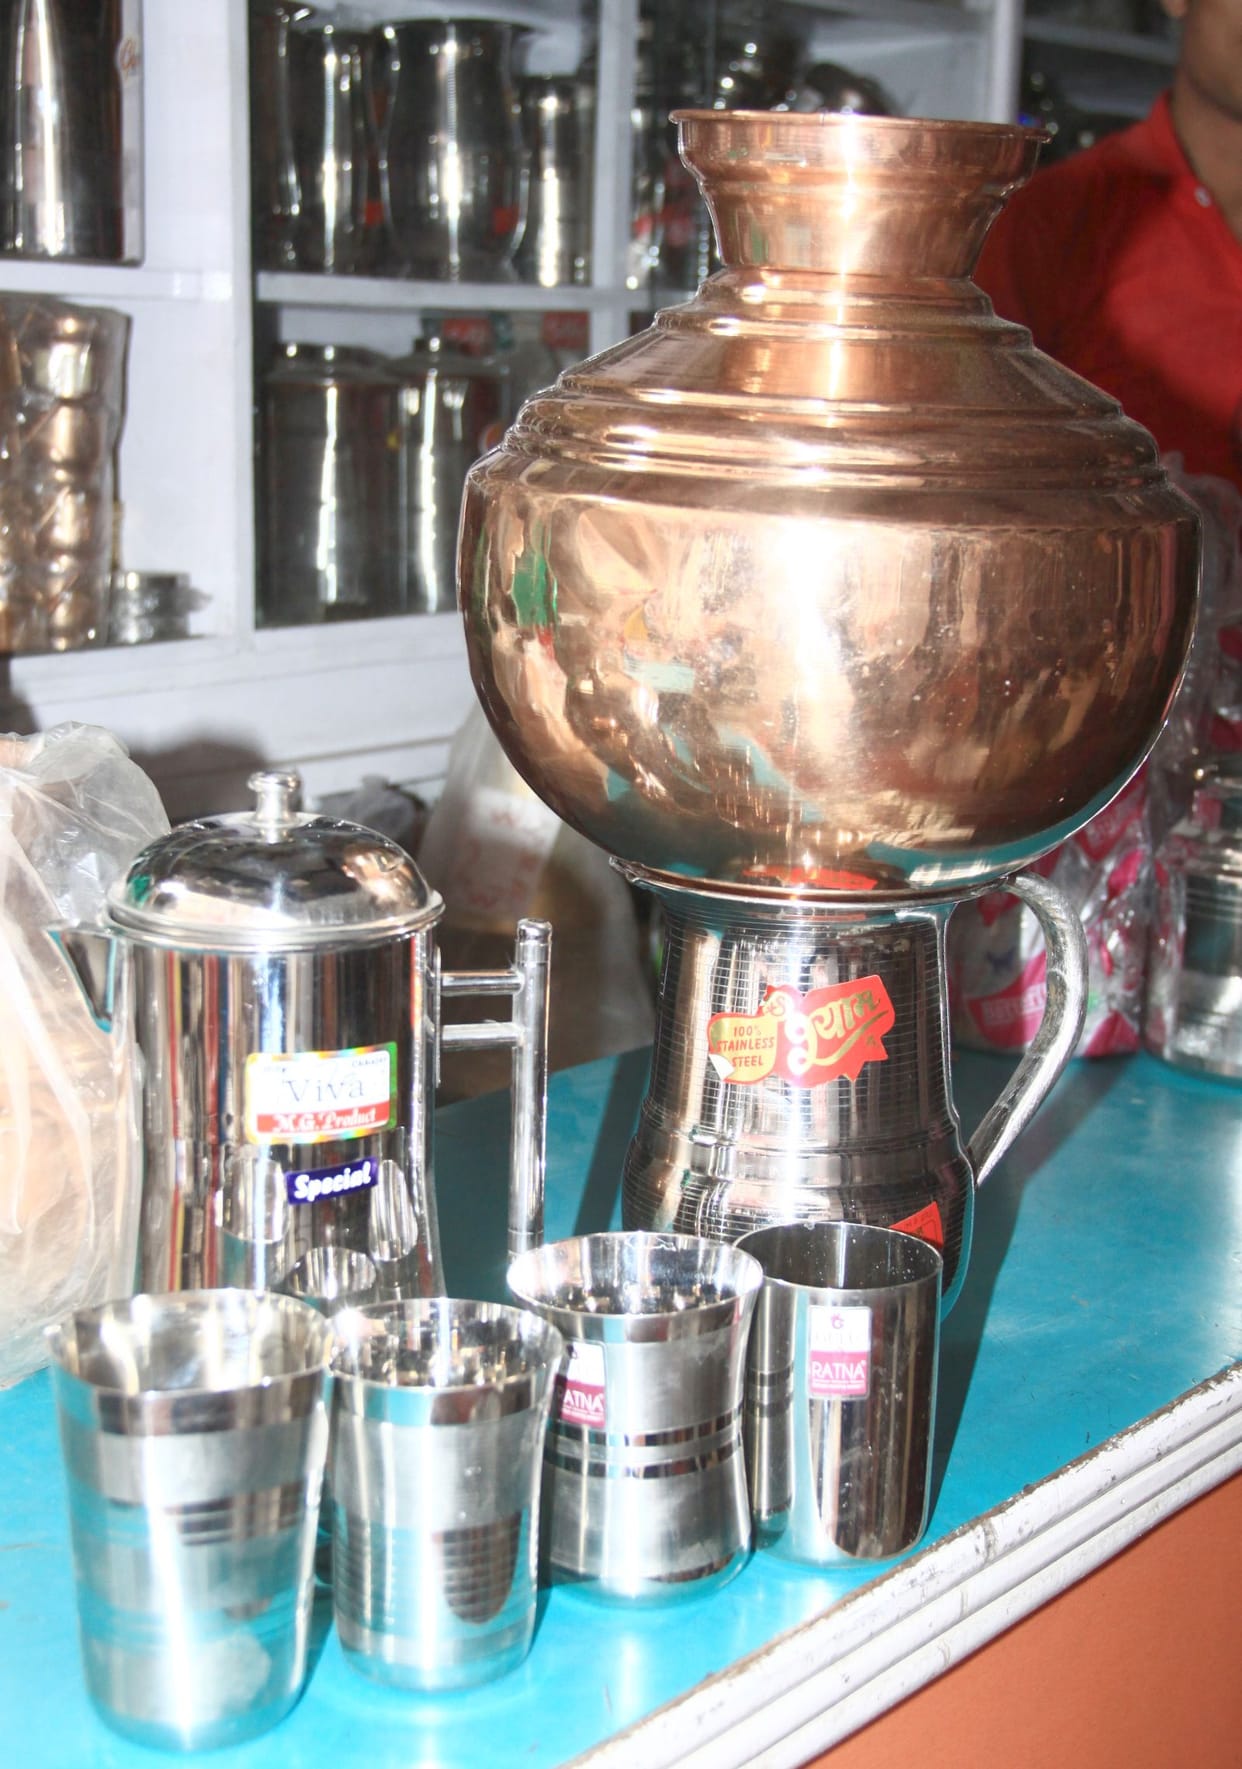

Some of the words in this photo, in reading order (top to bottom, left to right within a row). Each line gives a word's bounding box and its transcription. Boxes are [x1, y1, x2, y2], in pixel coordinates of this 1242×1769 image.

[716, 1037, 775, 1053] STAINLESS
[731, 1055, 764, 1068] STEEL
[282, 1079, 364, 1102] Viva
[319, 1107, 377, 1130] Product
[294, 1161, 372, 1202] Special
